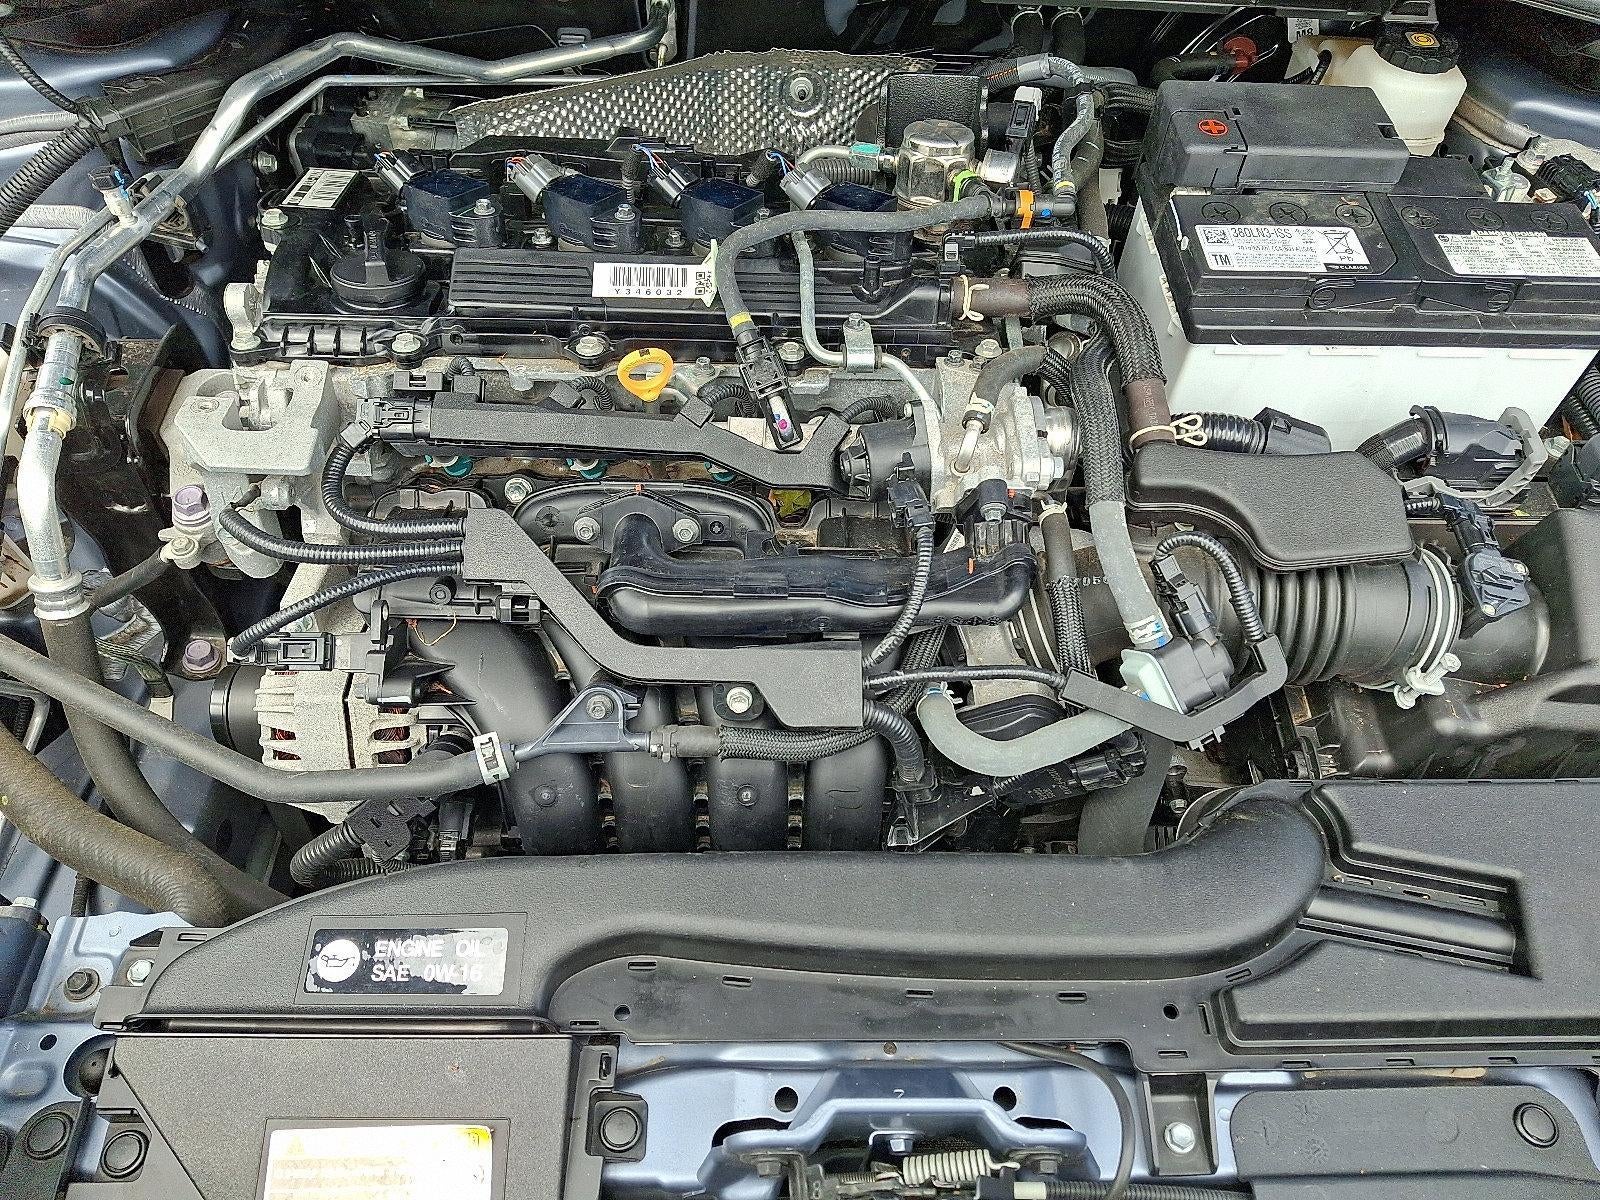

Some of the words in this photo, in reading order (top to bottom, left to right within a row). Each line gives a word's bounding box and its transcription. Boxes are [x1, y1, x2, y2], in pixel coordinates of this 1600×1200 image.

[1212, 254, 1231, 266] TM
[615, 288, 683, 296] Y346032
[373, 938, 444, 958] ENGINE
[456, 938, 486, 958] OIL
[371, 963, 411, 982] SAE
